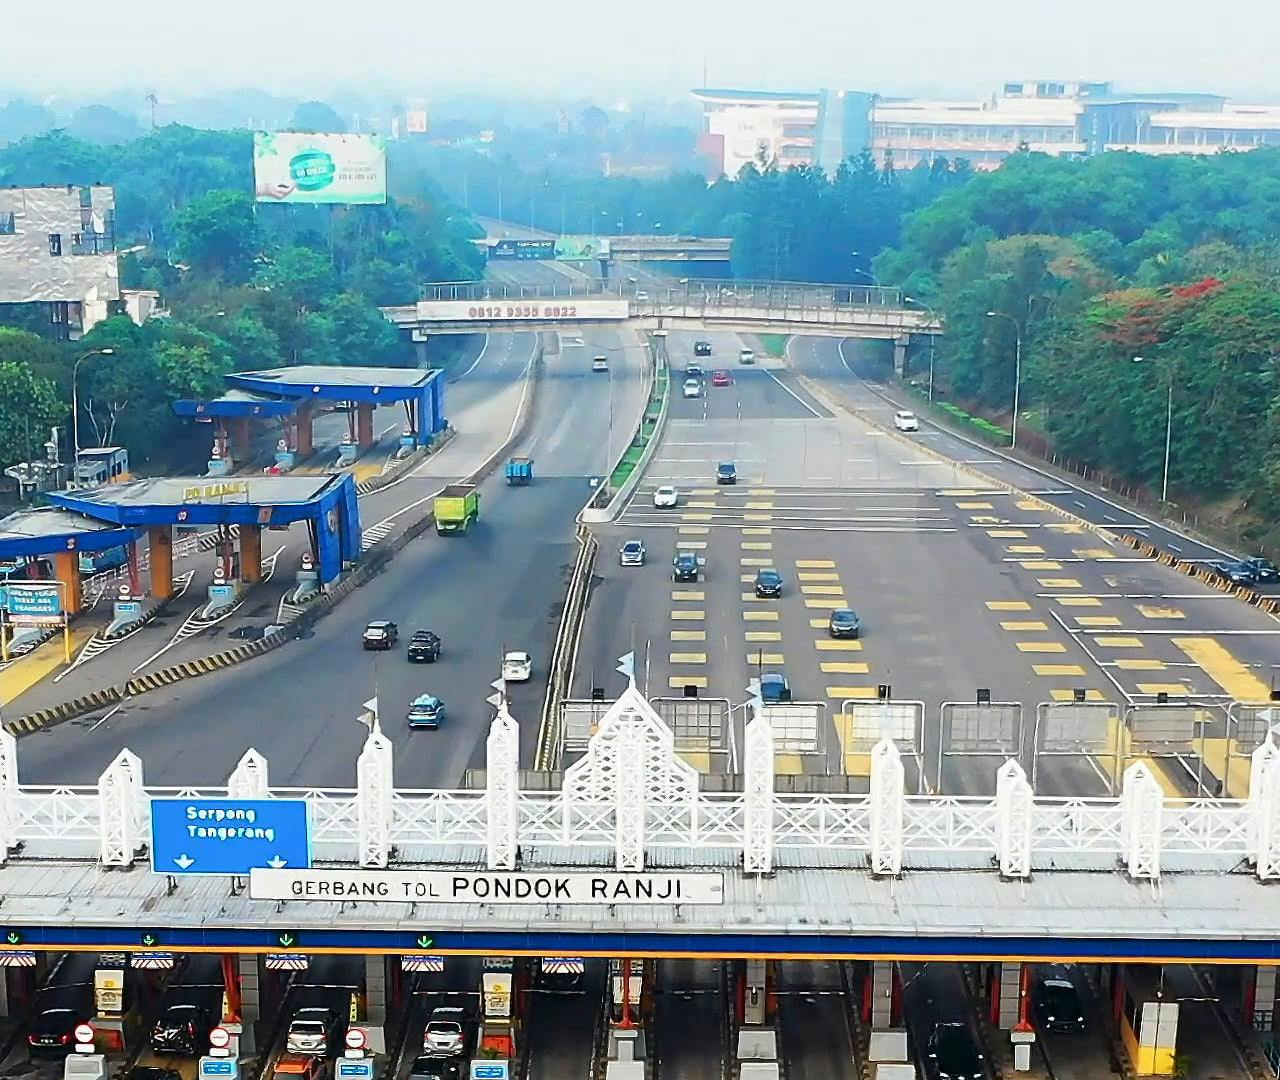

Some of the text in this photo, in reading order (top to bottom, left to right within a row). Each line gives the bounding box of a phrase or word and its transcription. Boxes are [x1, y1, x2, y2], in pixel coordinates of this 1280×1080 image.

[186, 806, 256, 824] Serpong
[187, 825, 275, 842] Tangerang
[291, 877, 682, 900] GERBANG TOL PONDOK RANJI
